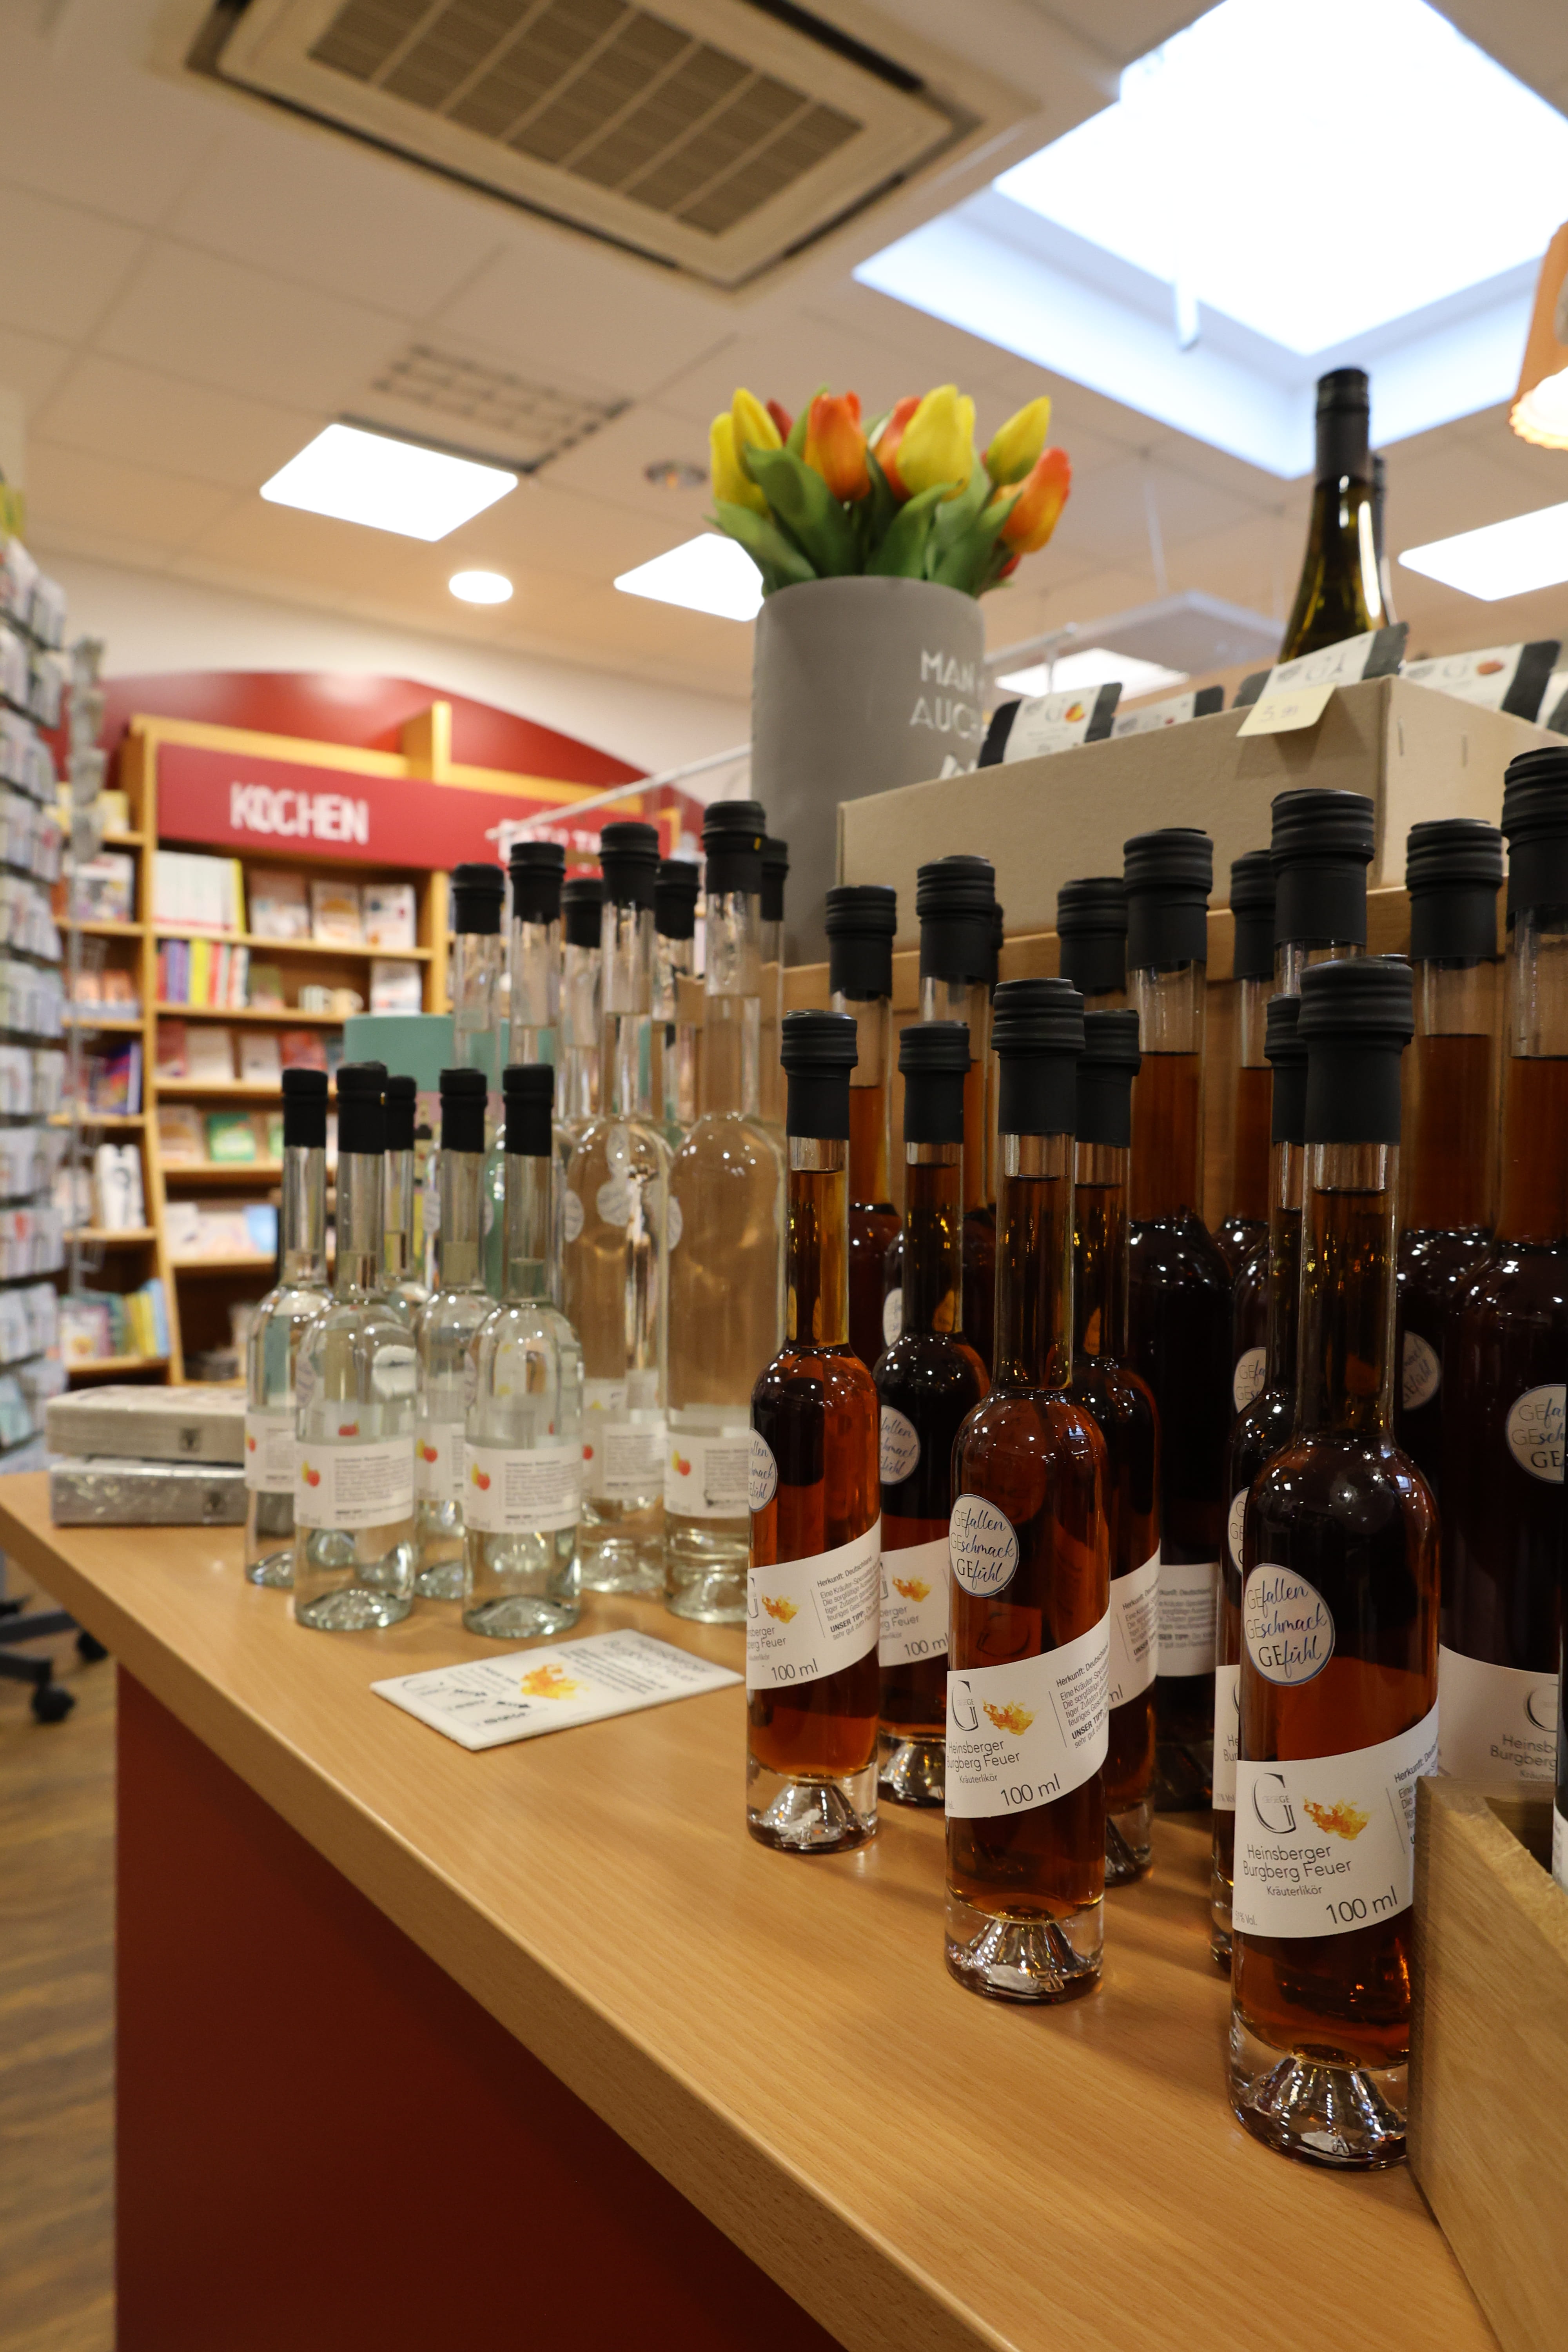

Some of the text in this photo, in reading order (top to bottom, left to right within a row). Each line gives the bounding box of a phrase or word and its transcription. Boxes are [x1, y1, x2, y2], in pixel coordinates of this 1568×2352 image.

[230, 782, 370, 844] KOCHEN
[954, 1508, 1006, 1538] GEfallen
[951, 1532, 1014, 1558] GEschmack
[957, 1558, 1004, 1590] GEfühl
[1247, 1577, 1308, 1618] GEfallen
[830, 1619, 851, 1632] UNSER
[1246, 1602, 1328, 1639] GEschmack
[760, 1637, 786, 1648] Feuer
[904, 1632, 950, 1656] 100 ml
[1258, 1635, 1322, 1679] GEfühl
[771, 1658, 818, 1681] 100 ml
[1056, 1667, 1085, 1688] Herkunft:
[1060, 1689, 1074, 1701] Eine
[1062, 1700, 1074, 1710] Die
[1065, 1707, 1079, 1719] tiger
[1071, 1720, 1093, 1740] UNSER
[948, 1740, 1004, 1756] Heinsberger
[1502, 1734, 1557, 1753] Heinsb
[983, 1753, 1020, 1767] Feuer
[959, 1773, 998, 1784] Kräuterlikör
[1000, 1773, 1060, 1806] 100 ml
[1247, 1844, 1331, 1864] Heinsberger
[1243, 1860, 1352, 1882] Burgberg Feuer
[1267, 1885, 1323, 1896] Kräuterlikör
[1326, 1886, 1398, 1924] 100 ml
